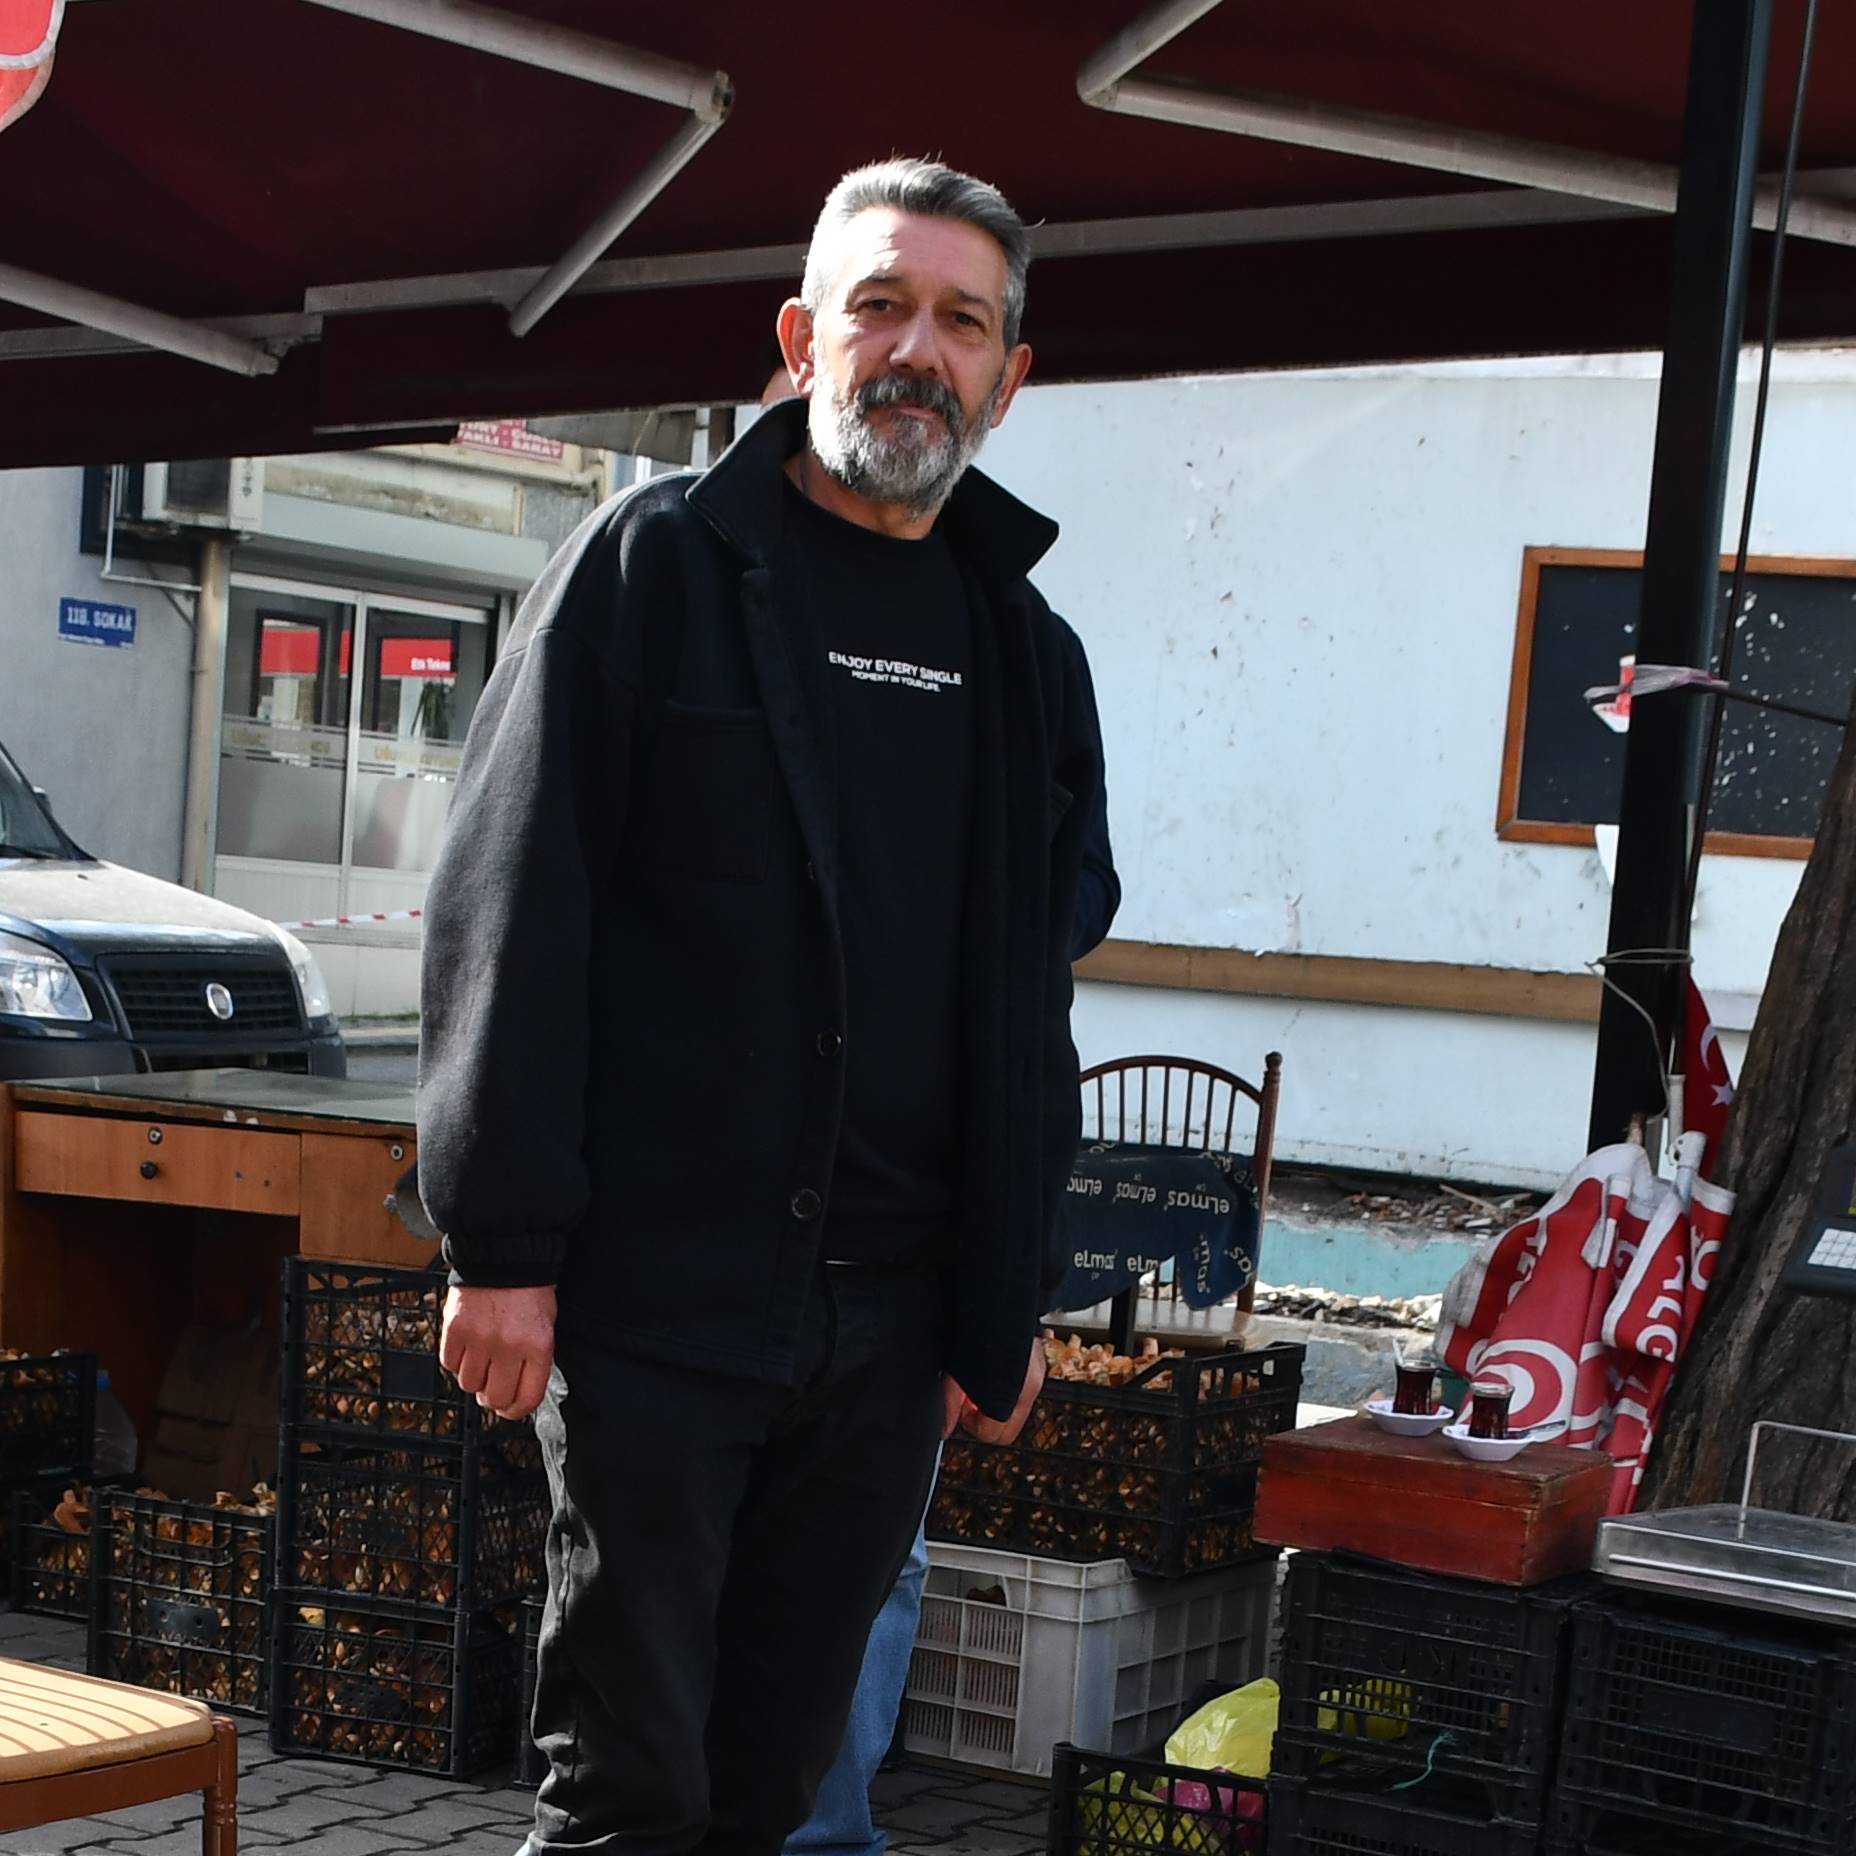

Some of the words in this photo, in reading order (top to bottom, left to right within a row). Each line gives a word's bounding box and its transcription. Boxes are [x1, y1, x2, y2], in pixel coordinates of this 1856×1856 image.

[829, 651, 873, 671] ENJOY
[875, 659, 919, 677] EVERY
[920, 667, 962, 685] SINGLE
[852, 670, 890, 682] MOMENT
[901, 676, 923, 689] YOUR
